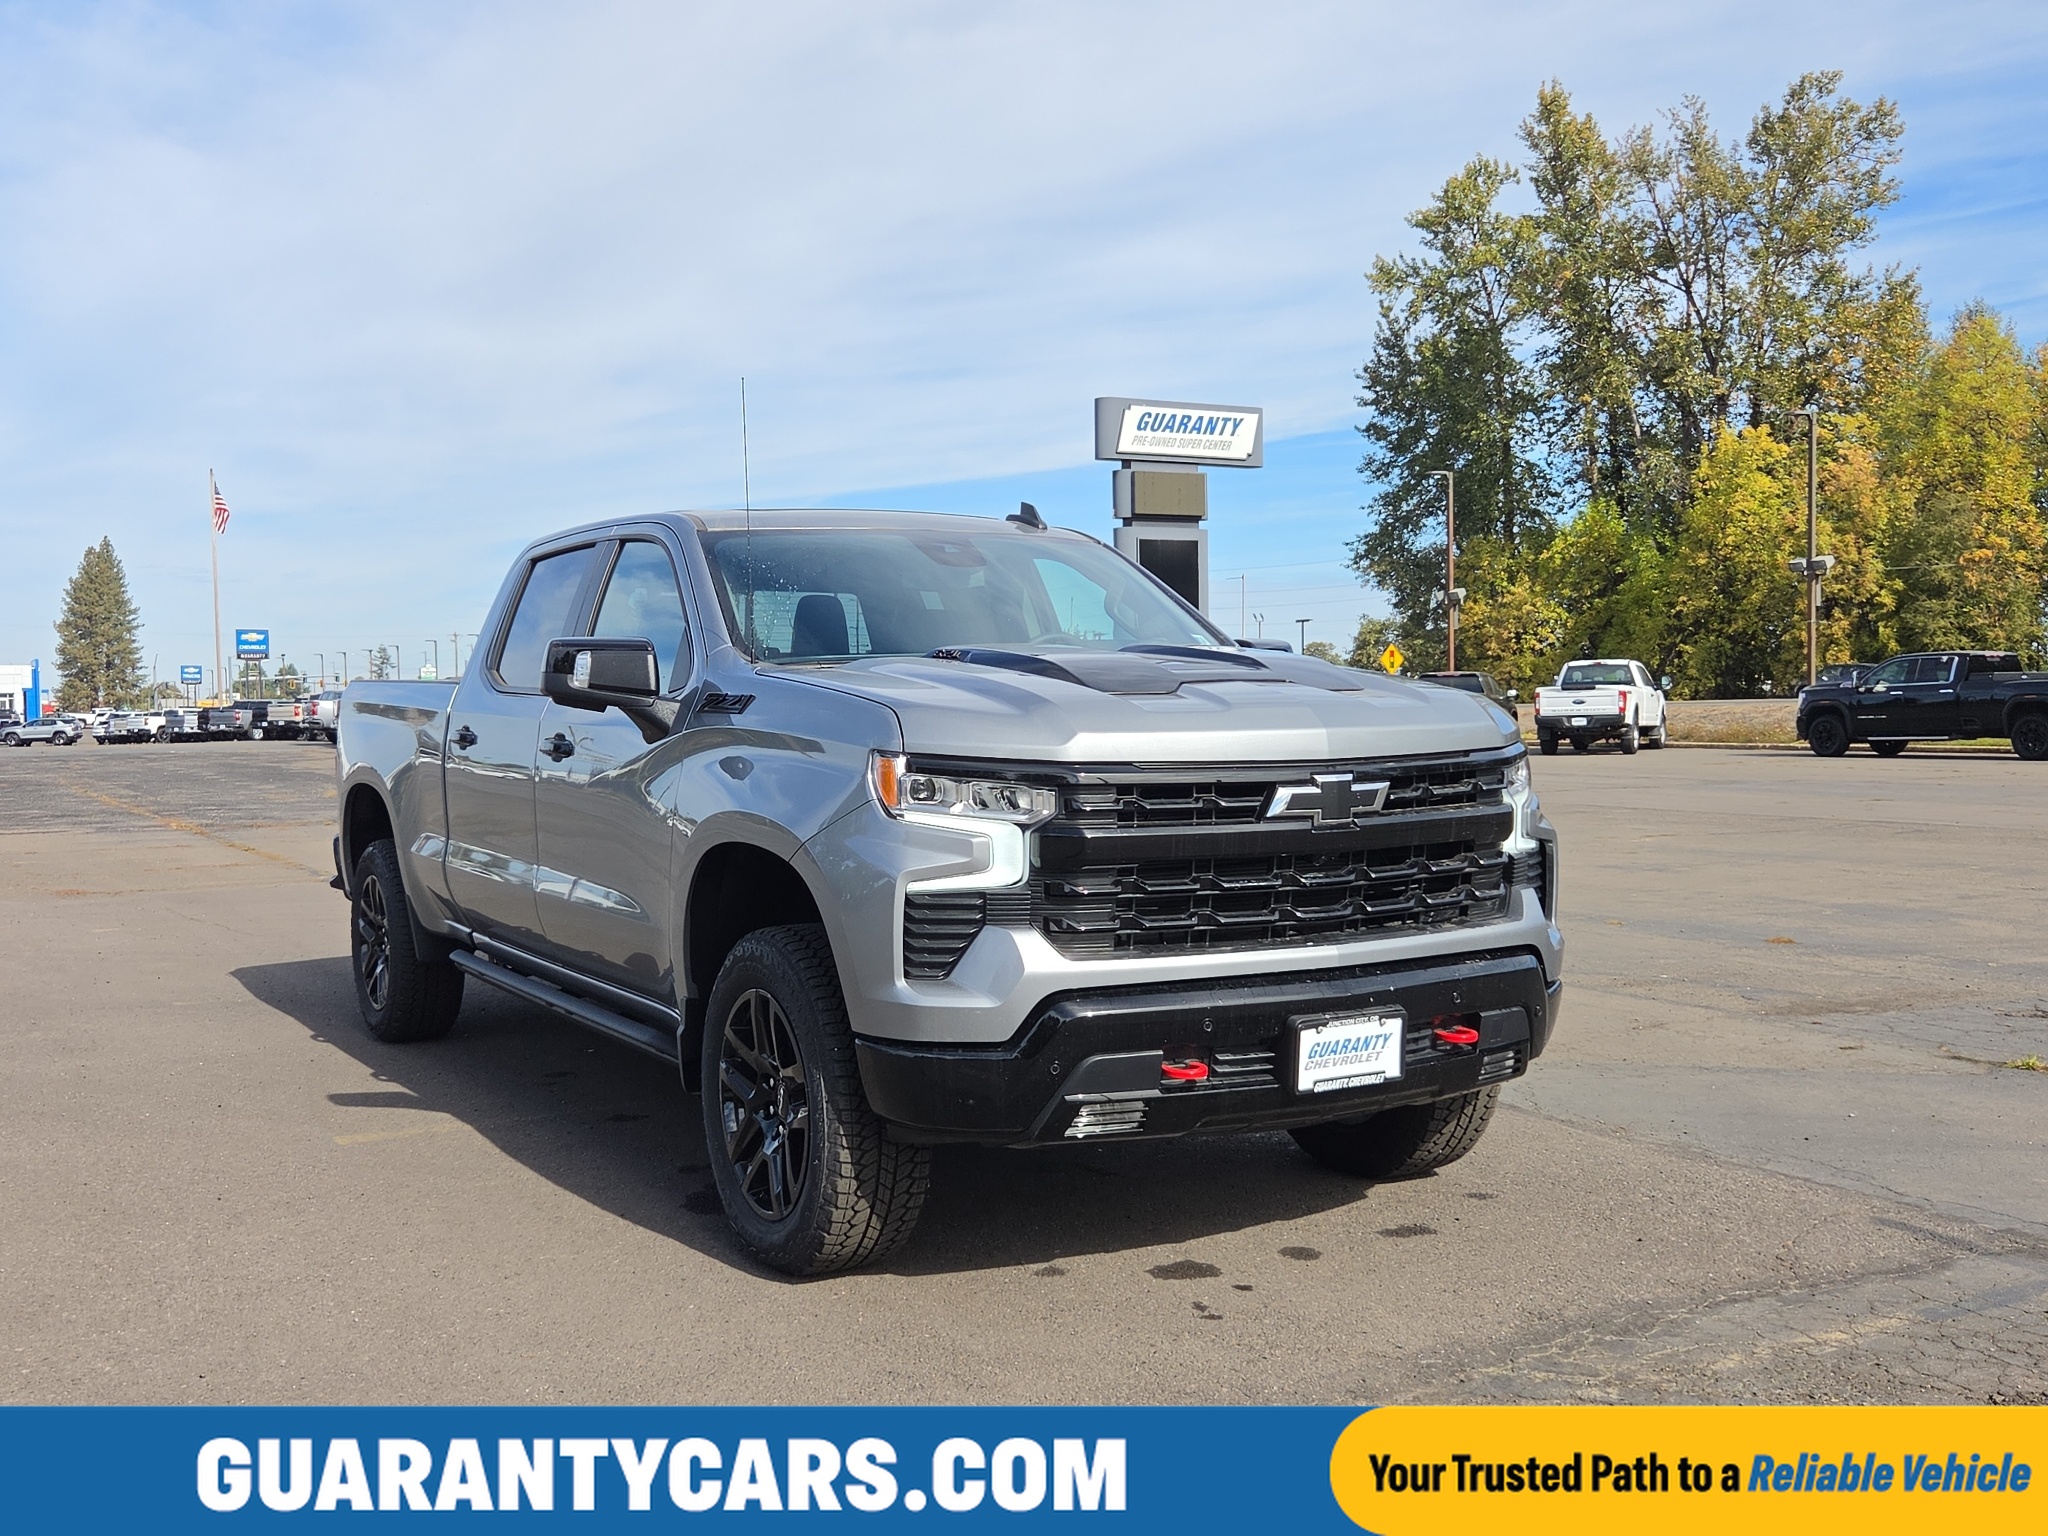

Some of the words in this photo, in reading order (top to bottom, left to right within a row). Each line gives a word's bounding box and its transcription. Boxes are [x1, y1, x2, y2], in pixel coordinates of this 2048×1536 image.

[1137, 411, 1244, 437] GUARANTY
[1131, 435, 1177, 448] PRE-OWNED
[1177, 437, 1202, 450] SUPER
[1202, 439, 1233, 452] CENTER
[1307, 1033, 1393, 1059] GUARANTY
[1304, 1051, 1383, 1071] CHEVROLET
